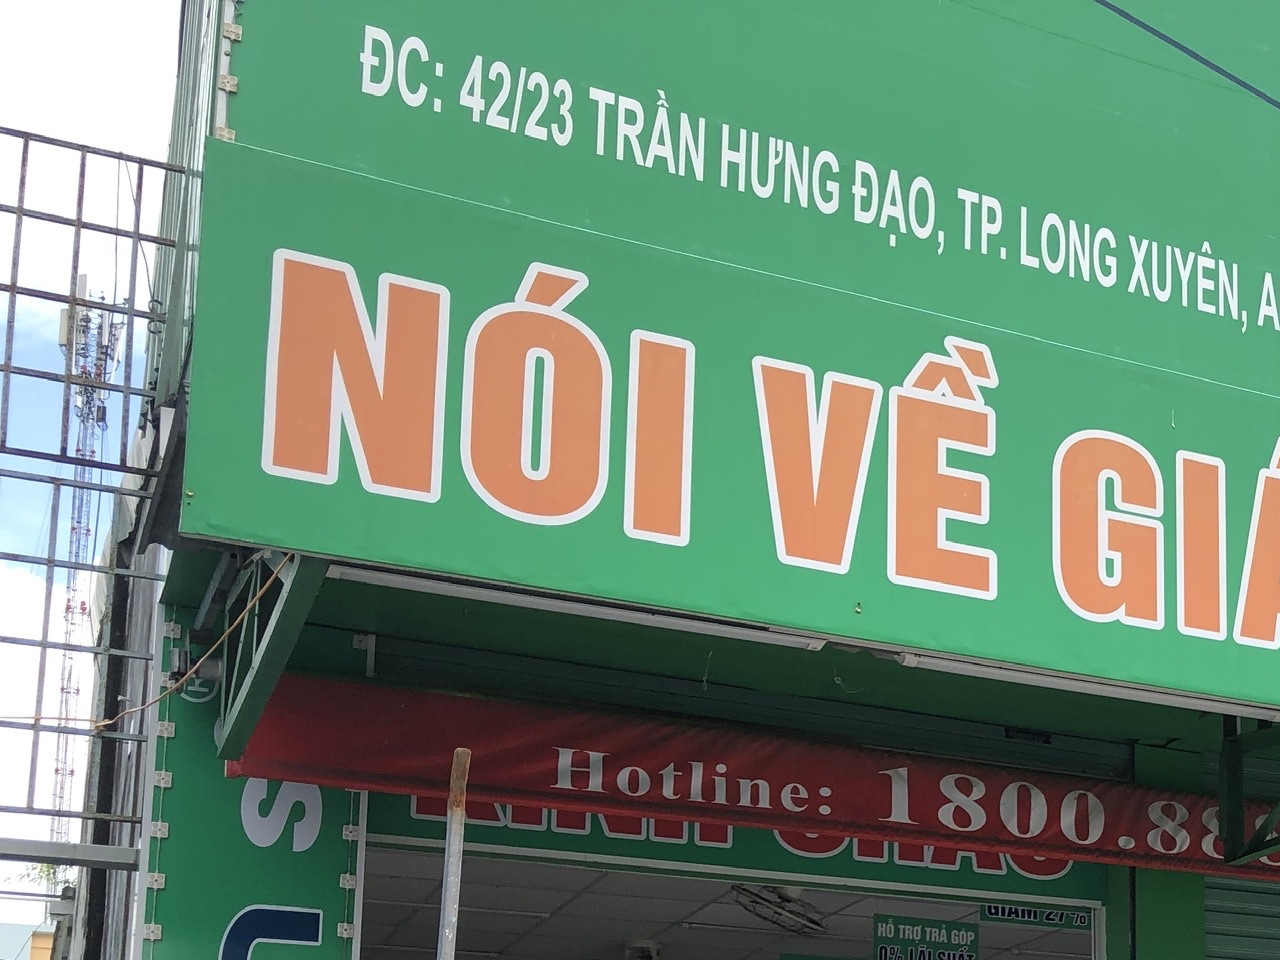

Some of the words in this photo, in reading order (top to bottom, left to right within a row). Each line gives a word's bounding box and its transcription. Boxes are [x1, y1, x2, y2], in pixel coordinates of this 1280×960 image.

[359, 24, 443, 112] ĐC:
[459, 54, 574, 147] 42/23
[588, 88, 706, 182] TRẦN
[720, 122, 840, 215] HƯNG
[852, 159, 946, 254] ĐẠO,
[957, 187, 1007, 260] TP.
[1019, 205, 1118, 288] LONG
[1127, 234, 1247, 333] XUYÊN,
[261, 248, 696, 547] NÓI
[751, 335, 999, 601] VỀ
[240, 777, 323, 852] S
[549, 746, 833, 816] Hotline:
[924, 924, 948, 944] TRẢ
[951, 927, 975, 945] GÓP
